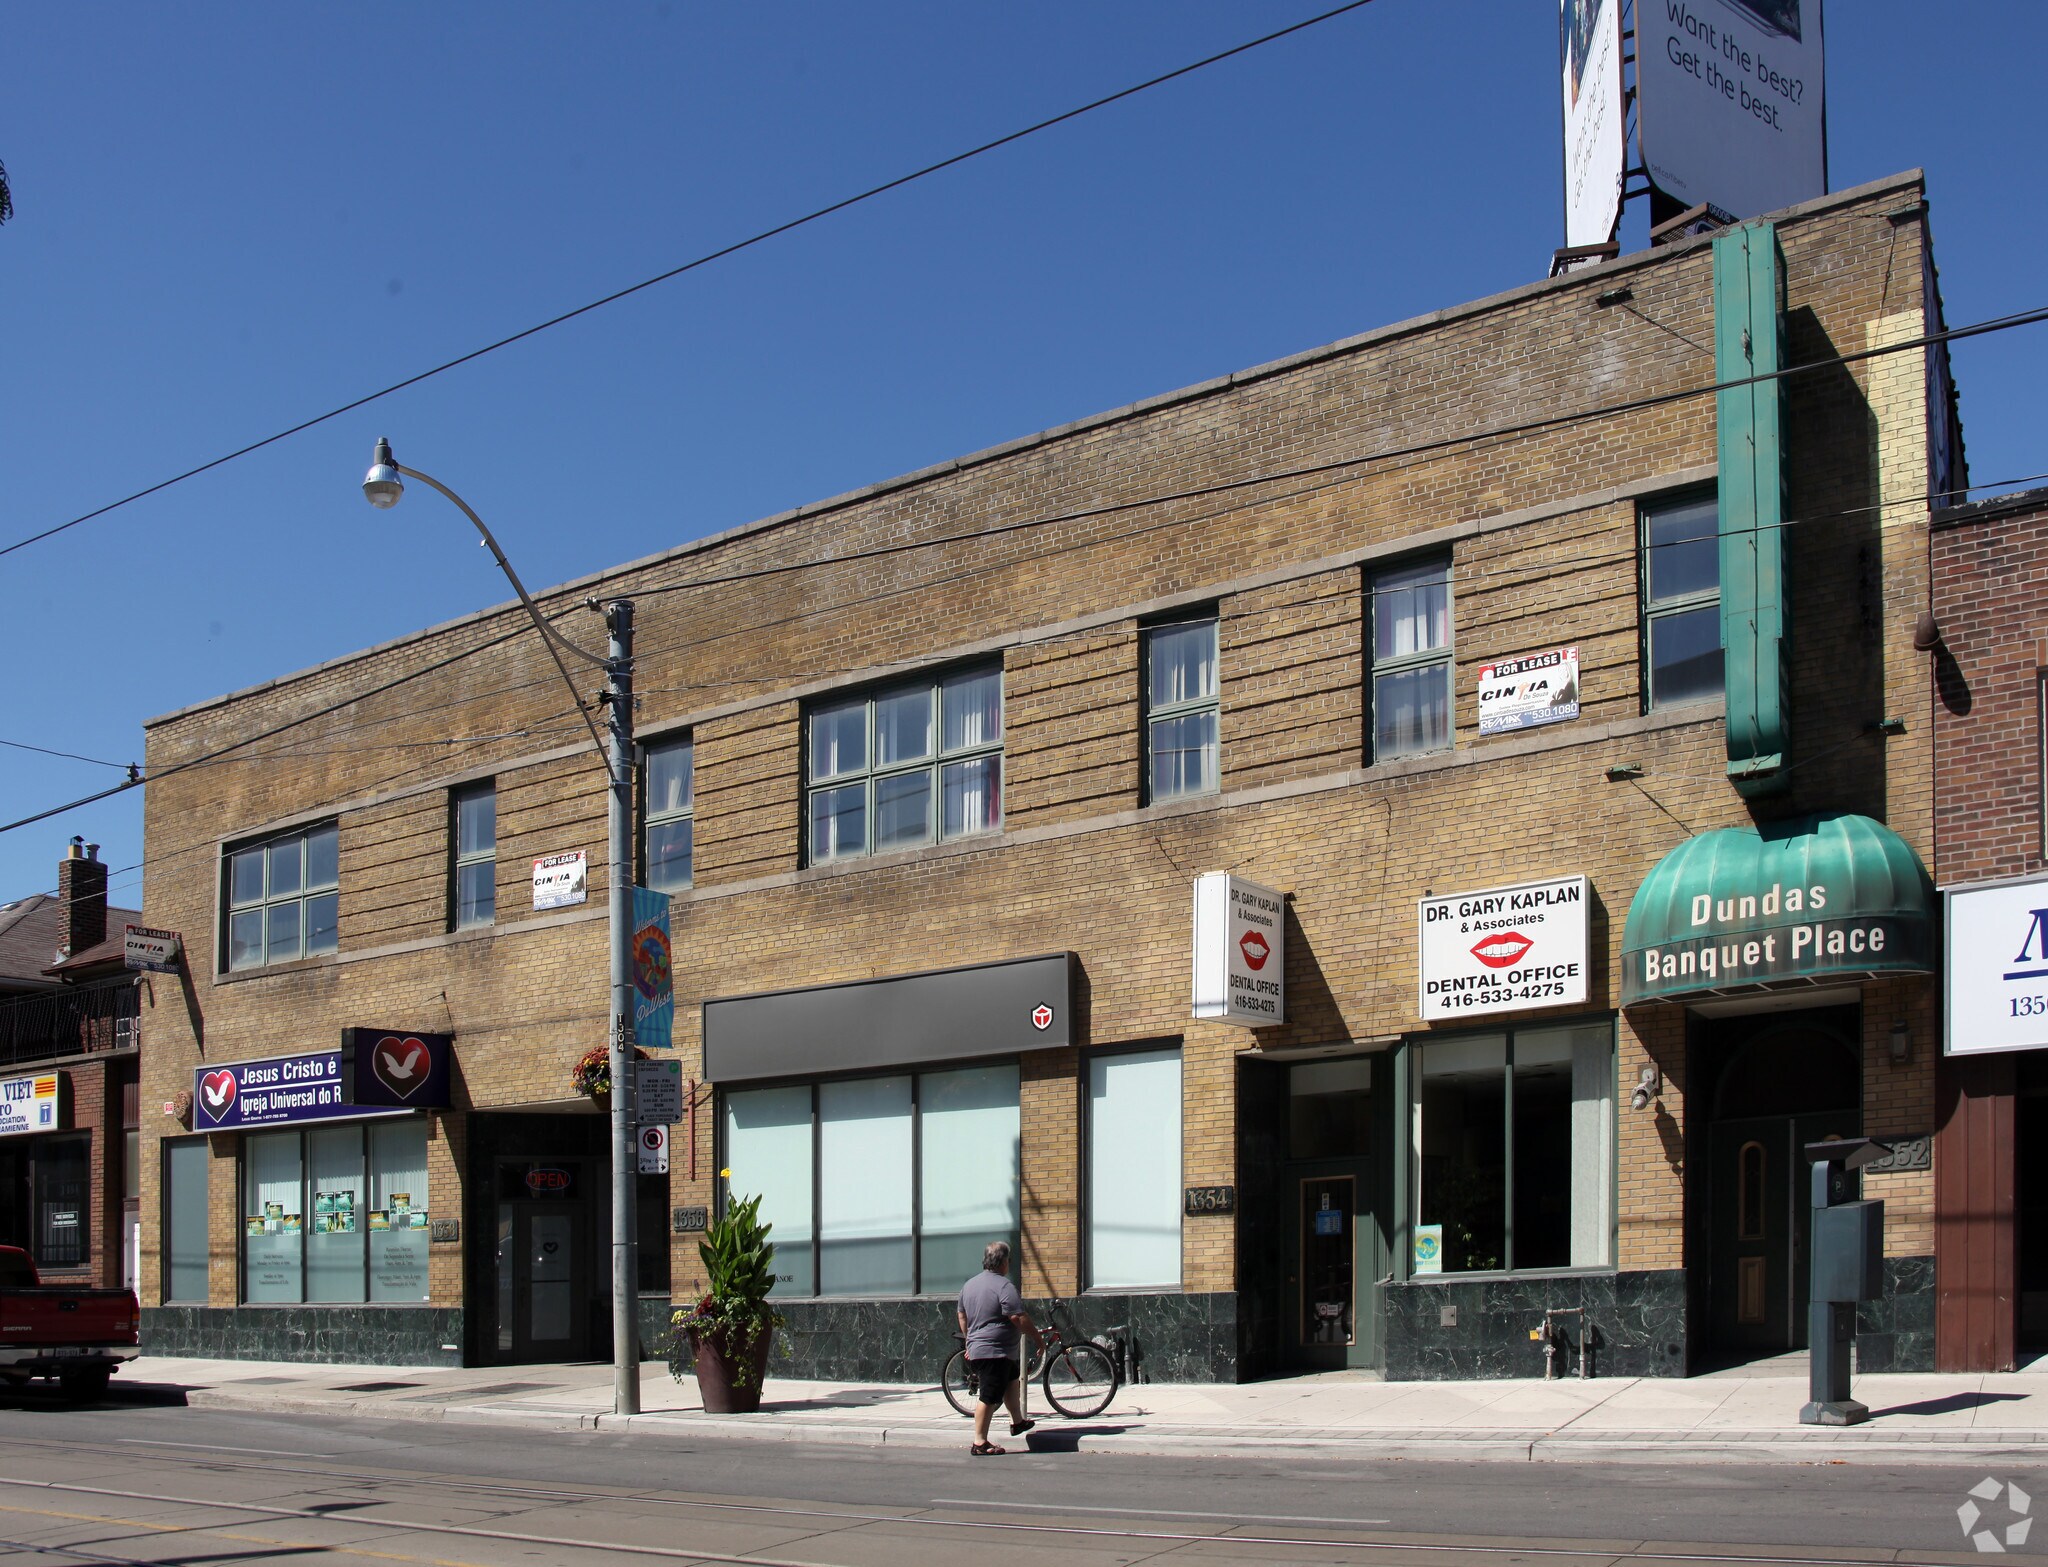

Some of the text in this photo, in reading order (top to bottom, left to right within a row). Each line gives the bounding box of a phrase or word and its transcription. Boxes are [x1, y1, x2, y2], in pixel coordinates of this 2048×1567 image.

[1666, 0, 1803, 106] Want the best?
[1667, 36, 1783, 132] Get the best.
[1496, 664, 1518, 677] FOR
[1522, 654, 1558, 671] LEASE
[1532, 703, 1577, 720] 530.1080
[544, 854, 577, 867] FOR LEASE
[1231, 888, 1280, 915] DR. GARY KAPLAN
[1426, 885, 1580, 923] DR. GARY KAPLAN
[1690, 883, 1827, 927] Dundas
[1237, 907, 1273, 928] & Associates
[1460, 913, 1545, 933] & Associates
[135, 928, 148, 936] FOR
[149, 930, 169, 939] LEASE
[1645, 924, 1885, 983] Banquet Place
[1230, 973, 1279, 997] DENTAL OFFICE
[1427, 963, 1579, 995] DENTAL OFFICE
[1234, 994, 1275, 1013] 416-533-4275
[1441, 982, 1565, 1009] 416-533-4275
[2009, 995, 2048, 1018] 135
[617, 1014, 625, 1052] T304
[240, 1056, 337, 1086] Jesus Cristo é
[240, 1095, 268, 1116] Igreja
[270, 1088, 316, 1111] Universal
[318, 1088, 332, 1105] do
[528, 1173, 568, 1187] OPEN
[1188, 1189, 1228, 1211] 1354
[674, 1210, 705, 1228] 1356
